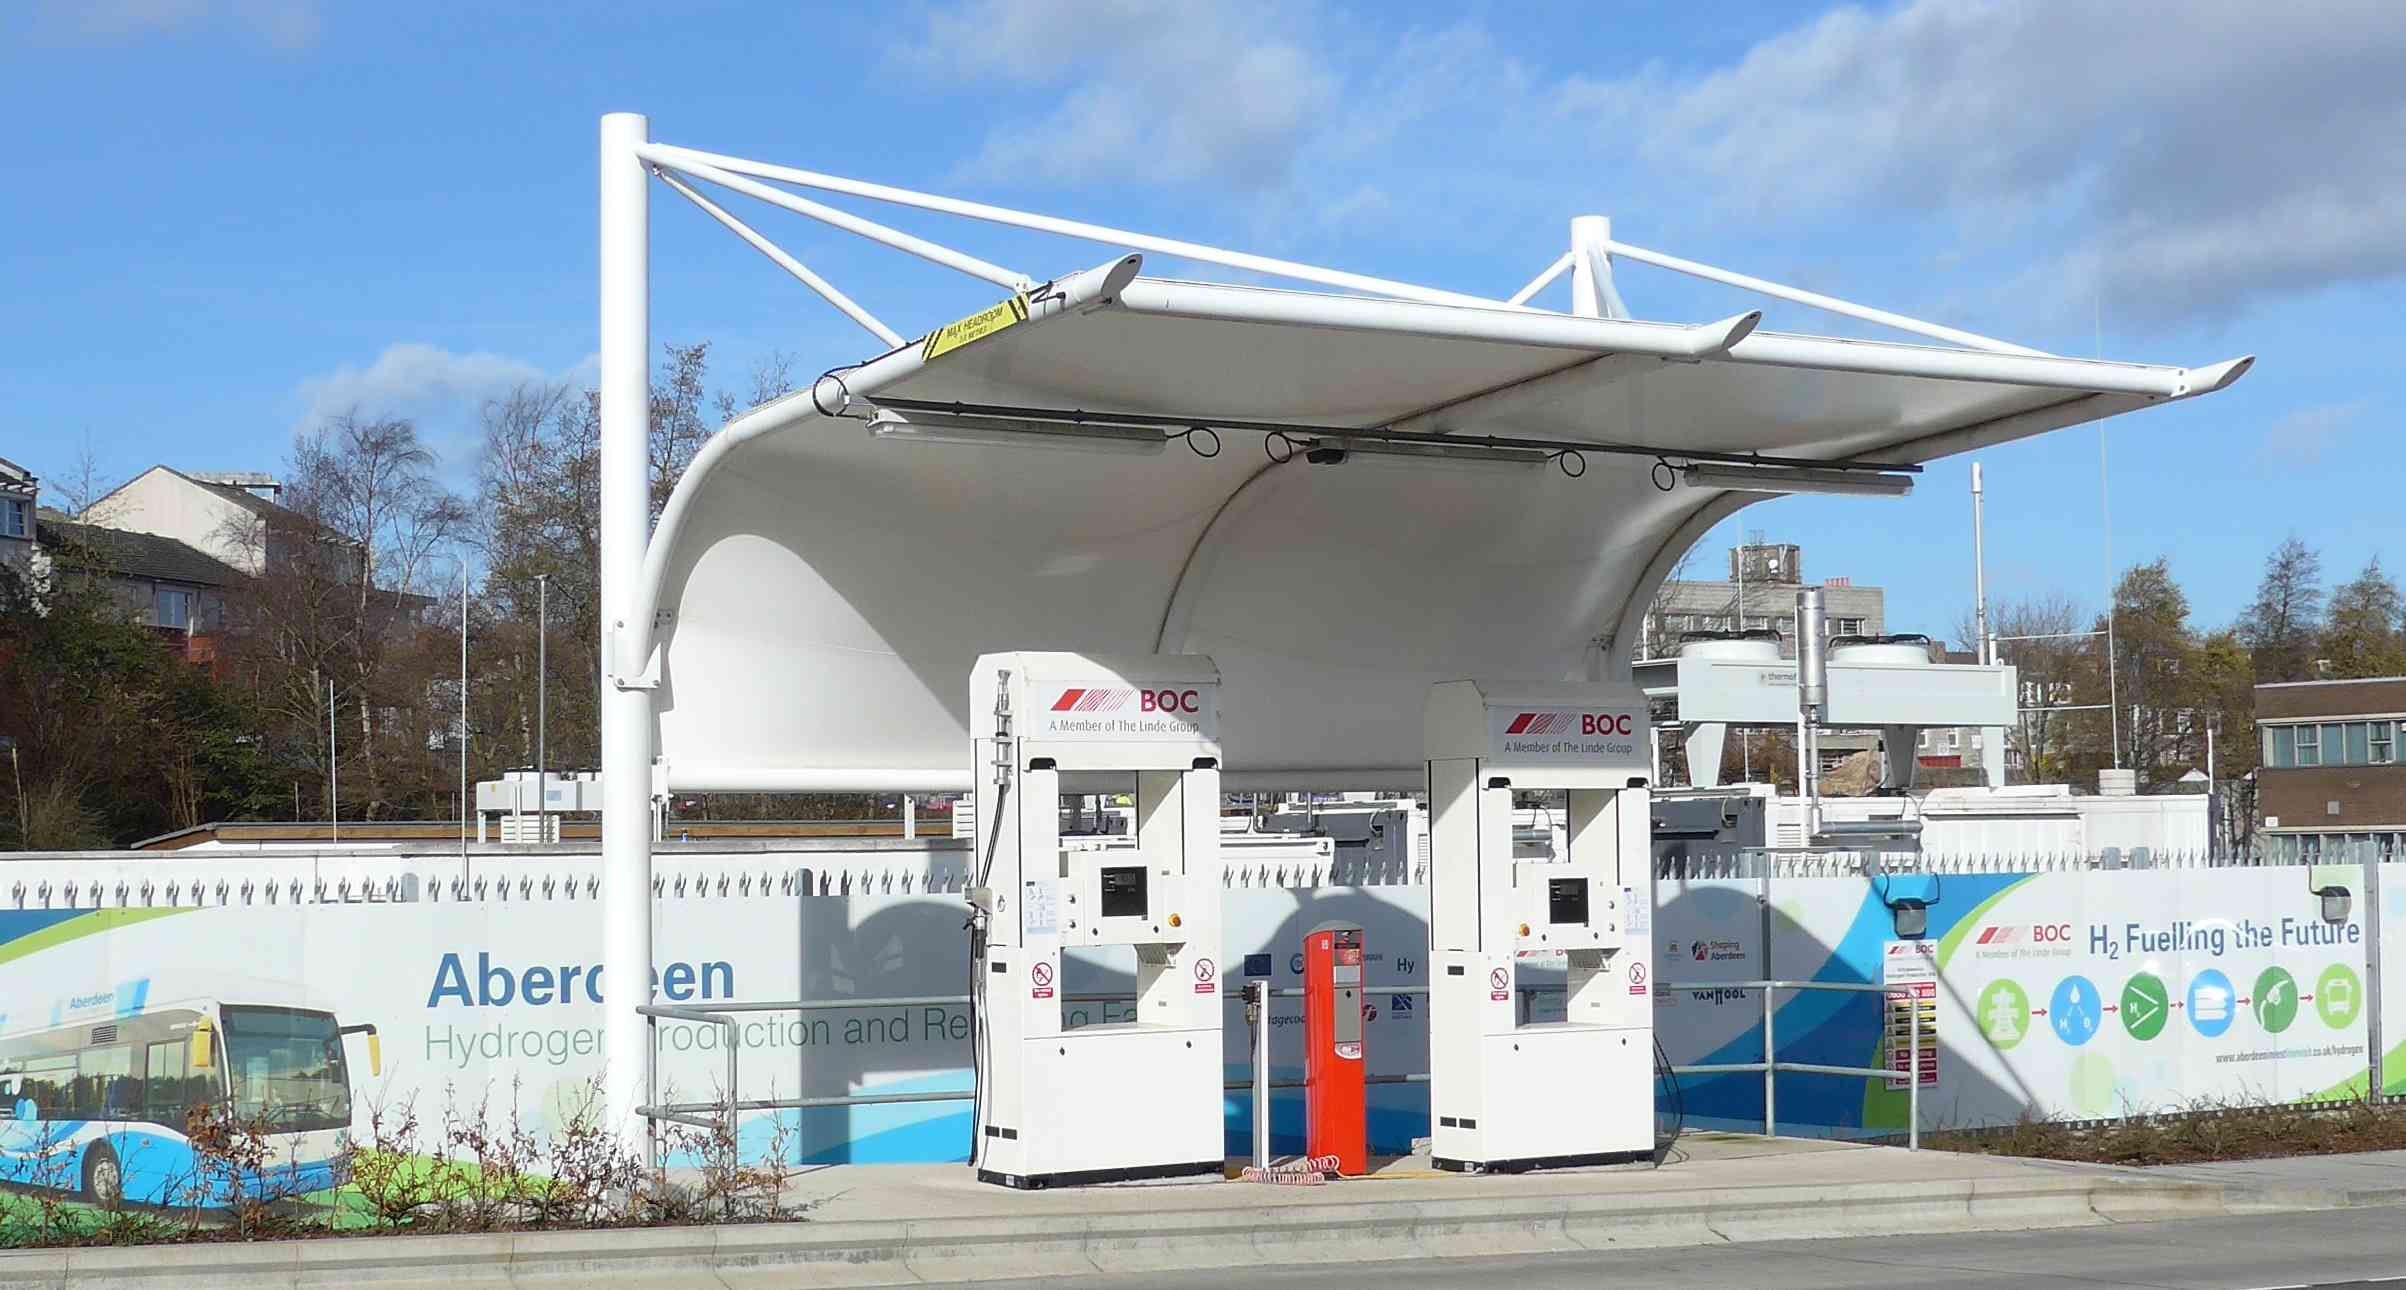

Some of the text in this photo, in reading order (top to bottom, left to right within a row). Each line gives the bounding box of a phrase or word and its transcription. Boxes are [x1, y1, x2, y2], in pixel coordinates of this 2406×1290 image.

[1140, 689, 1199, 713] BOC
[1049, 719, 1200, 734] A Member of The Linde Group
[1581, 713, 1632, 736] BOC
[1504, 741, 1633, 755] A Member of The Linde Group
[2033, 924, 2071, 942] BOC
[2126, 921, 2225, 957] Fuelling
[2233, 919, 2272, 948] the
[2281, 917, 2360, 946] Future
[1915, 944, 1934, 954] BOC
[1397, 957, 1415, 974] Hy
[70, 992, 114, 1009] Aberdeen
[659, 1013, 830, 1052] roduction
[843, 1007, 908, 1044] and
